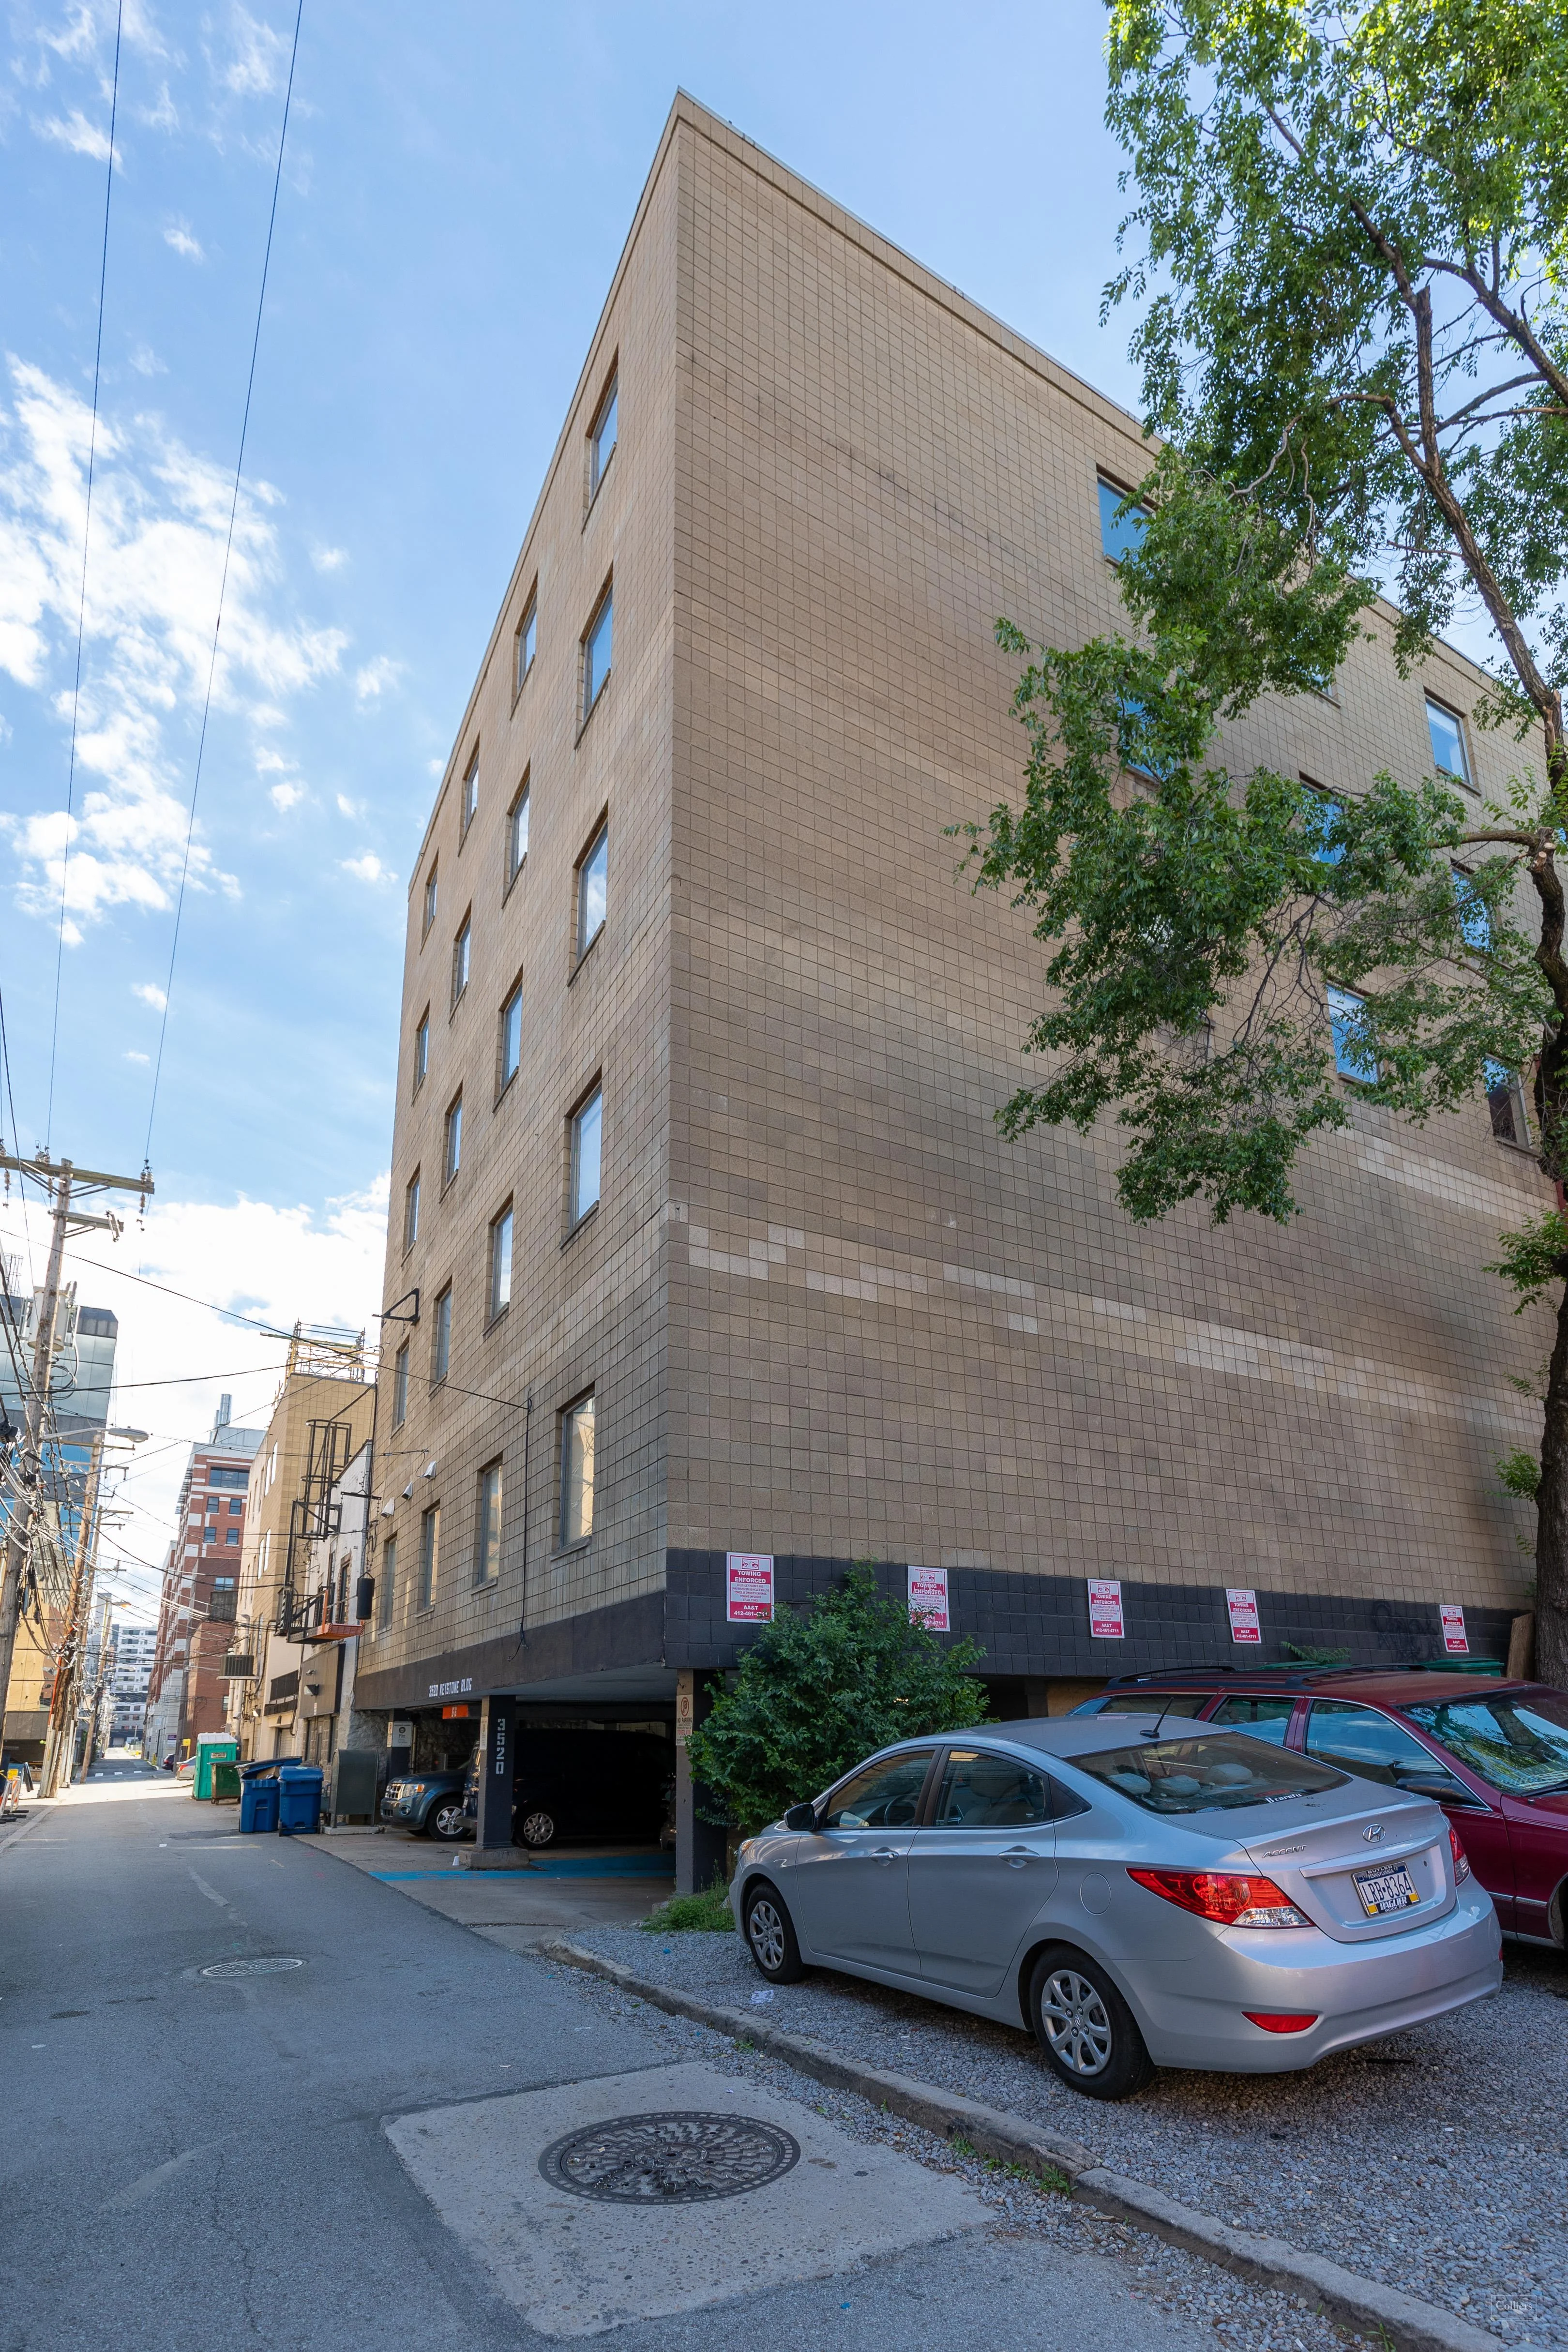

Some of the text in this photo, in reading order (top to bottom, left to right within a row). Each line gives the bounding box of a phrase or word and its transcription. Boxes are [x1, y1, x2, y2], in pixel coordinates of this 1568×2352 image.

[429, 1677, 472, 1698] 3520 KEYSTONE BLDG
[496, 1718, 506, 1774] 3520
[1262, 1844, 1307, 1859] ACCENT
[1368, 1865, 1393, 1874] BUTLER
[1368, 1869, 1394, 1879] PENNSYLVANIA
[1380, 1896, 1407, 1911] BAGLIER
